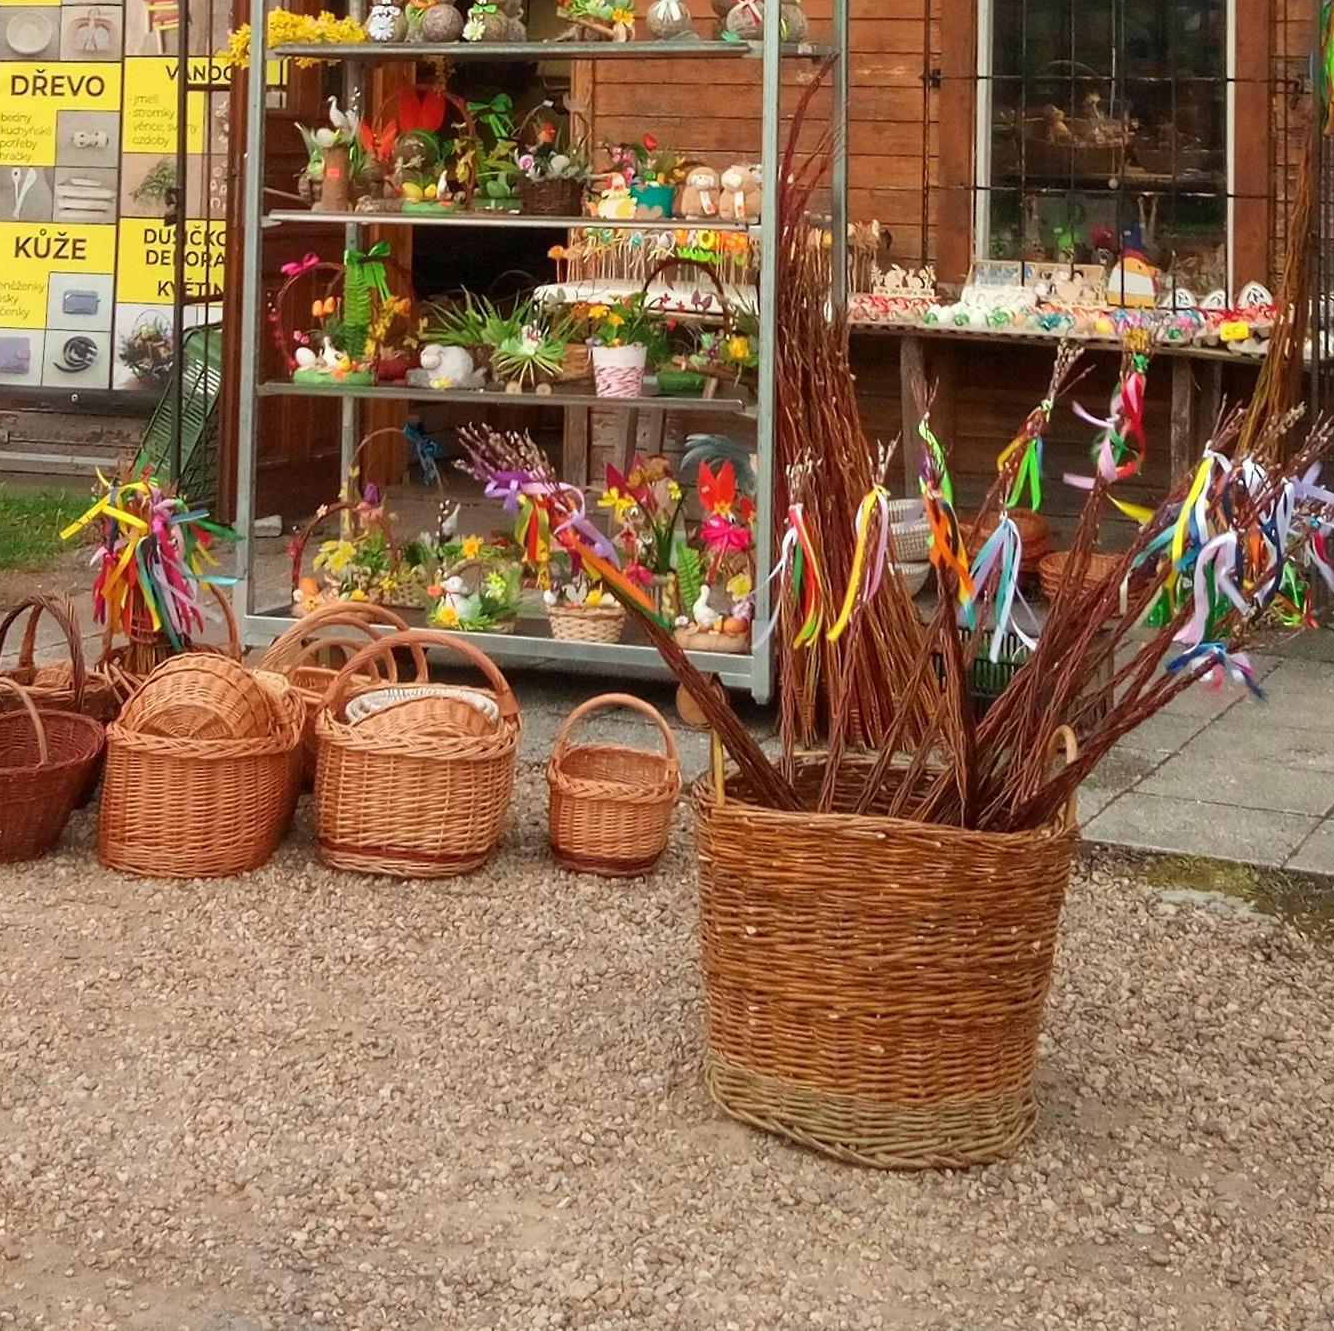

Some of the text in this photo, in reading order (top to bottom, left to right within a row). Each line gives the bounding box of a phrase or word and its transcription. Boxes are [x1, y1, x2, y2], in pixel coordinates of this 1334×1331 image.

[10, 69, 105, 98] DŘEVO
[14, 228, 87, 260] KŮŽE
[145, 250, 225, 267] DEORA
